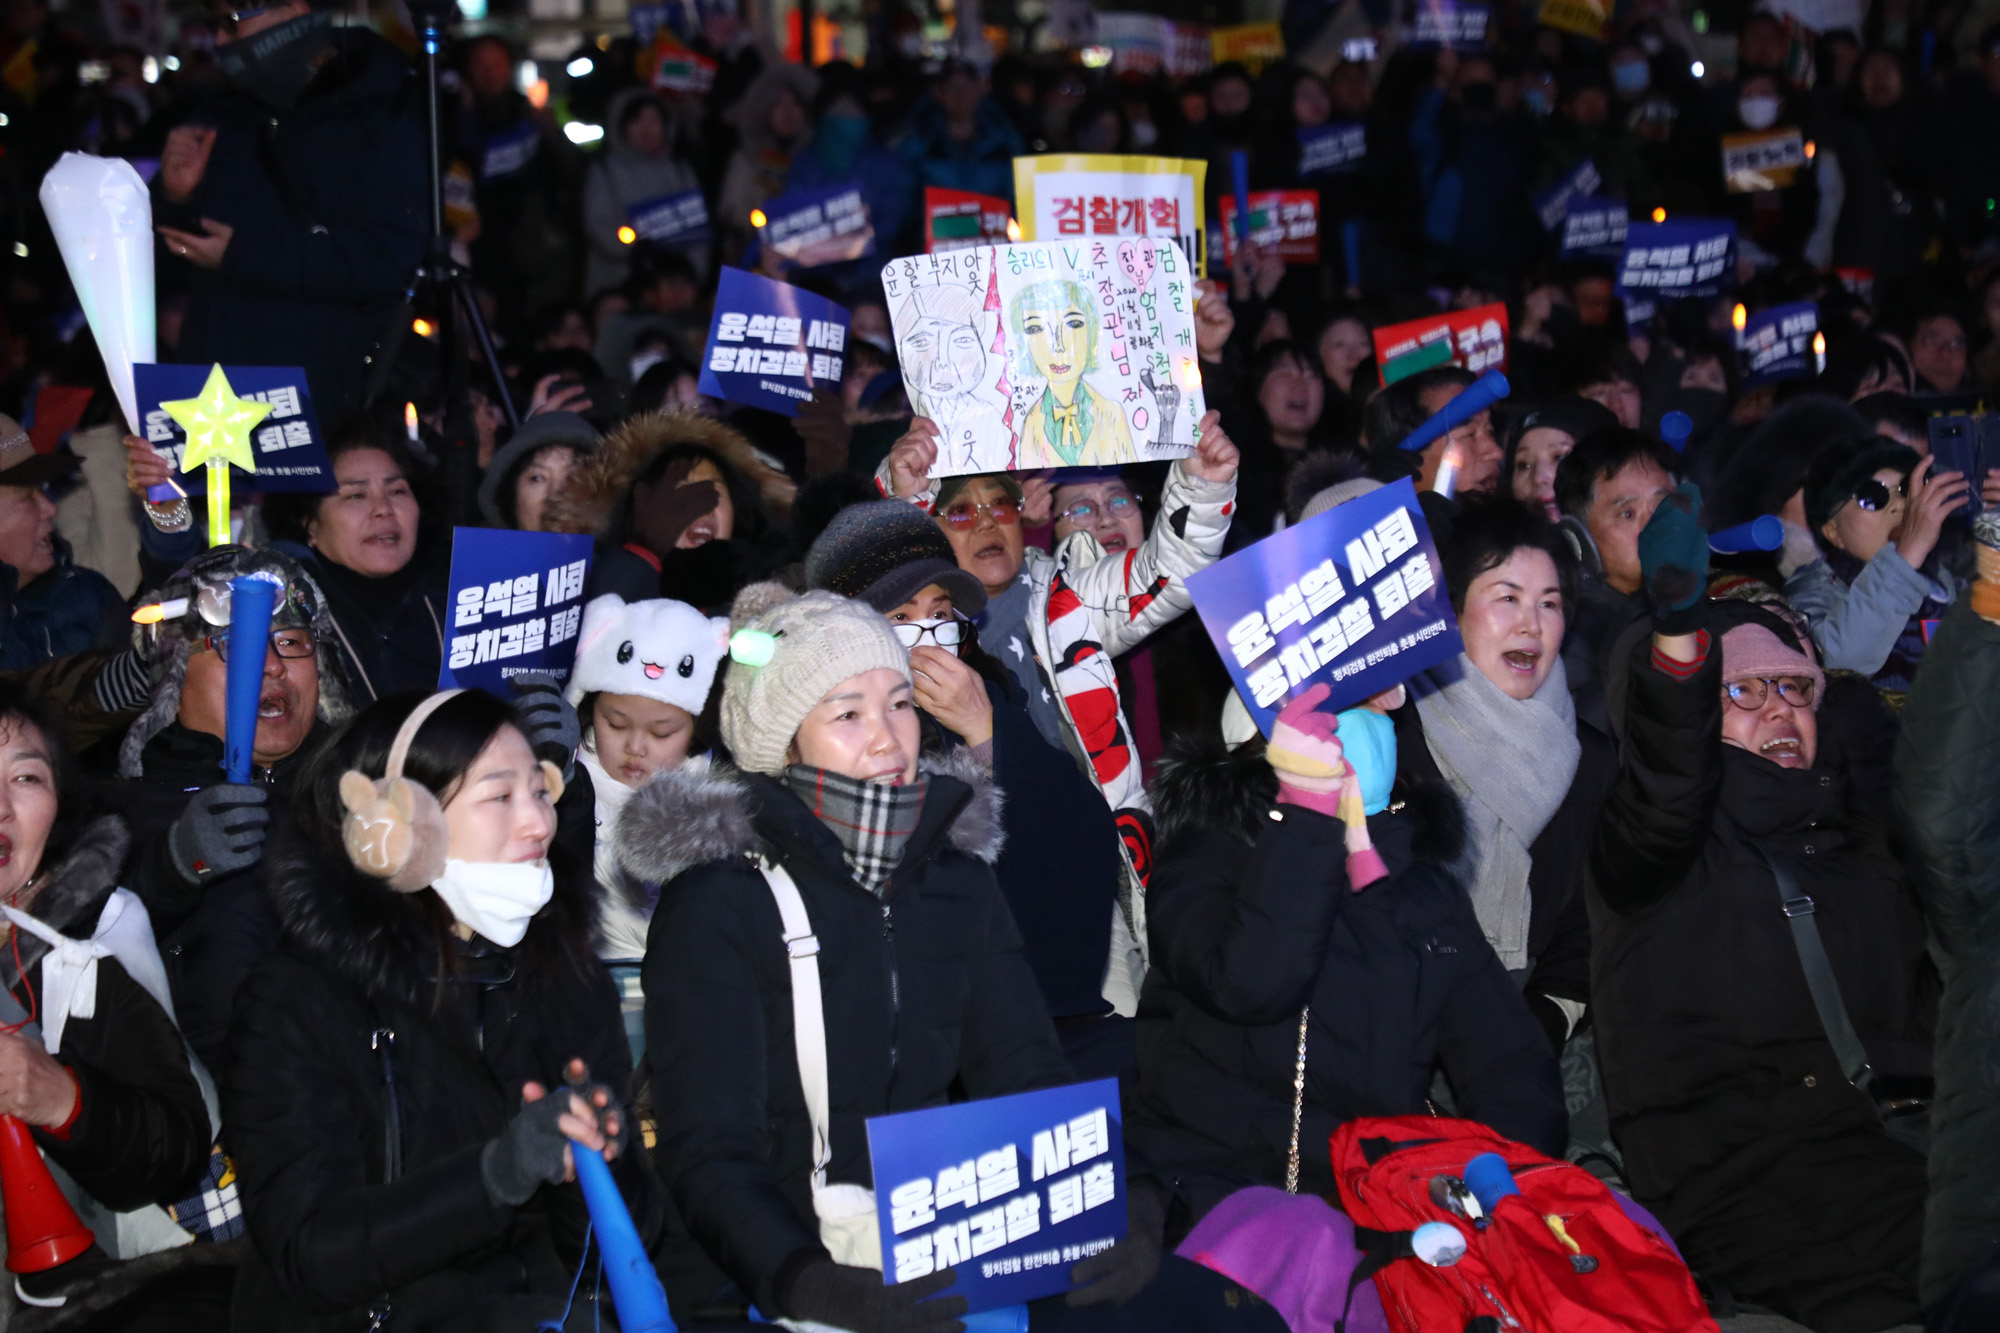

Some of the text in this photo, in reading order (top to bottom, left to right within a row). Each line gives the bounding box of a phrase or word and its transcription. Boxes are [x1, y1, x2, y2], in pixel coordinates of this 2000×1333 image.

[1050, 196, 1180, 237] 검찰개혁
[1007, 246, 1054, 275] 승리의
[1116, 287, 1138, 296] 2020
[717, 312, 846, 353] 윤석열 사퇴
[709, 346, 843, 382] 정치검찰 퇴출
[257, 420, 312, 454] 퇴출
[454, 558, 587, 628] 윤석열 사퇴
[1226, 505, 1419, 670] 윤석열 사퇴
[448, 604, 582, 670] 정치검찰 퇴출
[1246, 552, 1435, 709] 정치검찰 퇴출
[1332, 619, 1448, 682] 정치검찰 완전퇴출 촛불시민연대
[890, 1106, 1110, 1236] 윤석열 사퇴
[893, 1161, 1116, 1285] 정치검찰 퇴출
[982, 1257, 1021, 1279] 정치검찰
[1022, 1249, 1061, 1271] 완전퇴출
